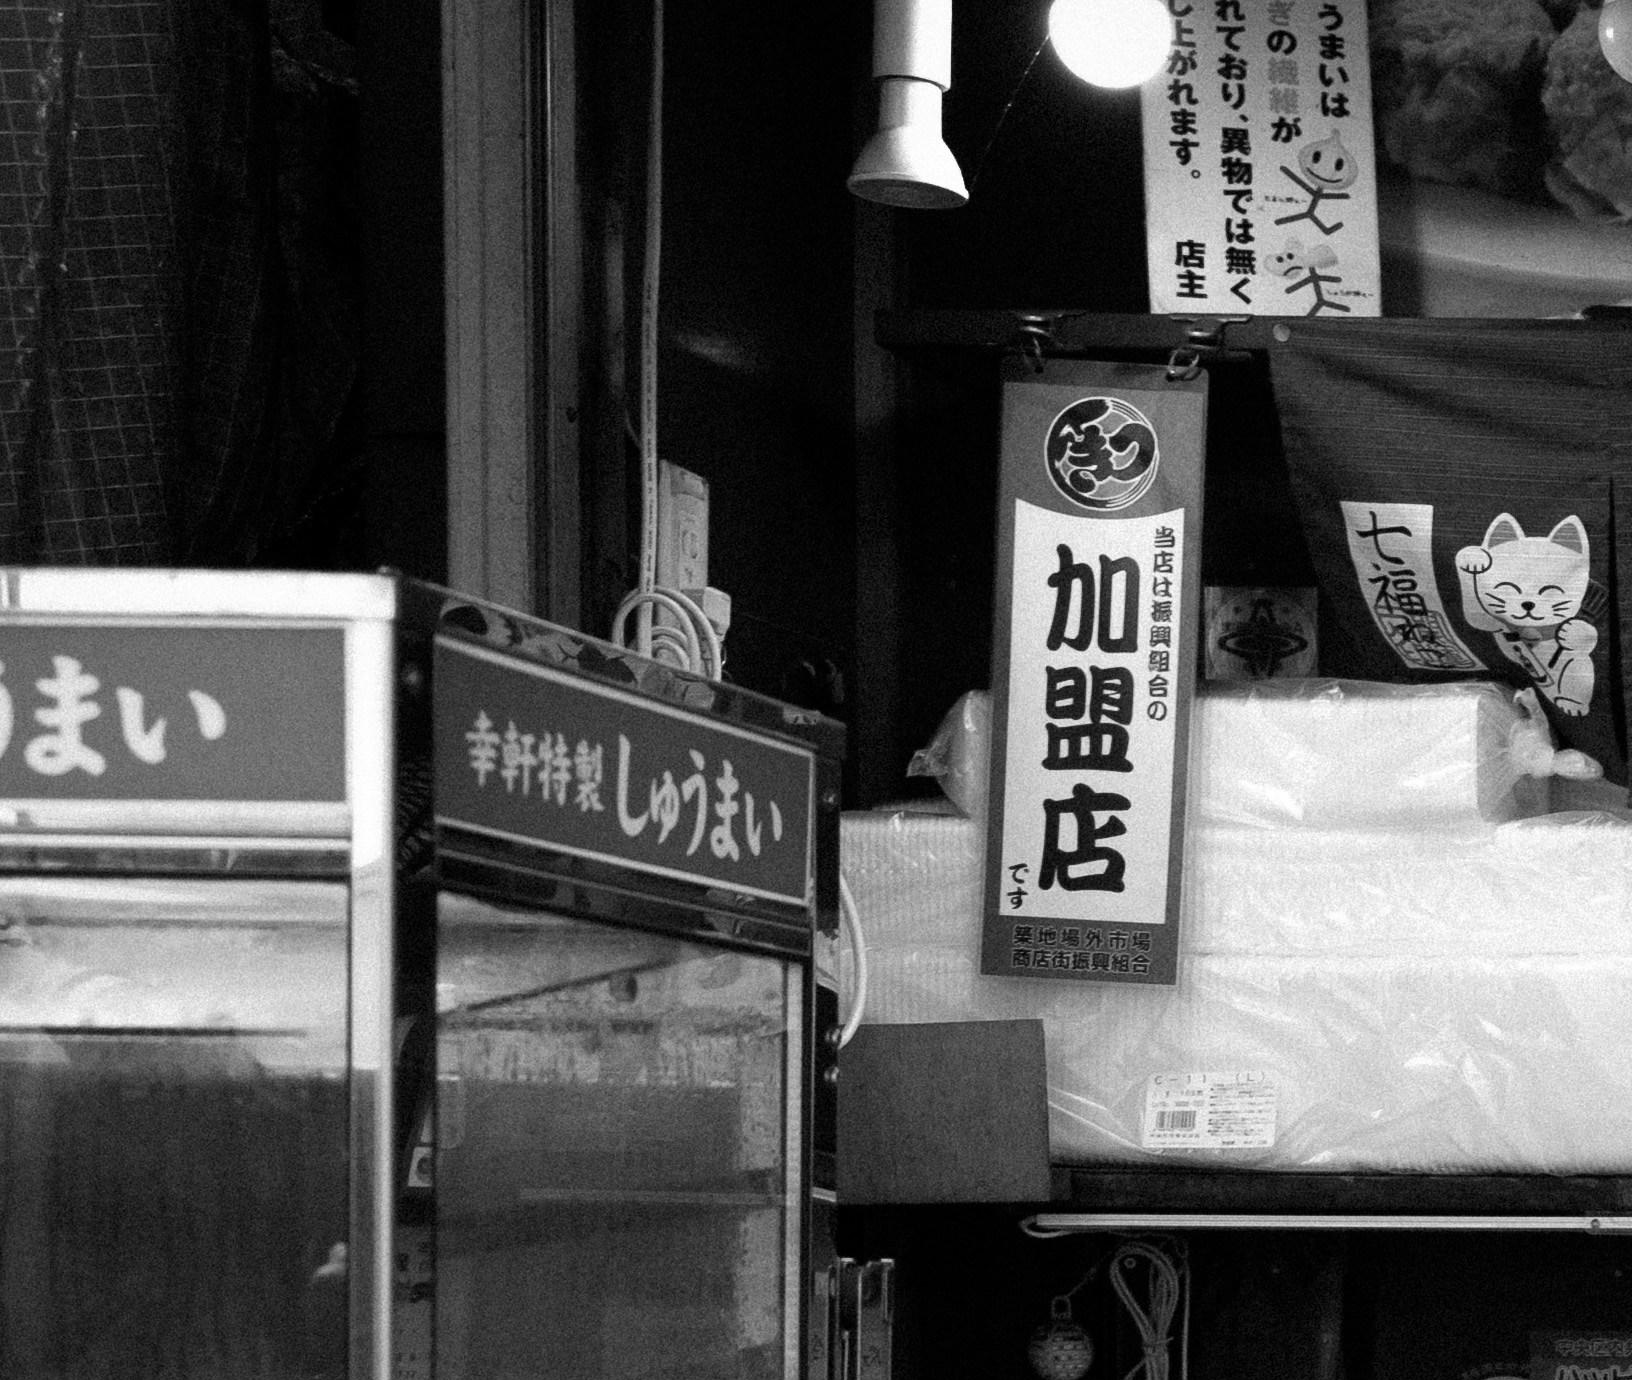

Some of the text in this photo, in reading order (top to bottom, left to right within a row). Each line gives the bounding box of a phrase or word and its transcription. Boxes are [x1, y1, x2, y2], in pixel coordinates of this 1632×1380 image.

[1174, 240, 1208, 299] 店主
[1147, 526, 1175, 722] 当店は振興組合の
[0, 650, 226, 777] まい
[1037, 543, 1141, 894] 加盟店
[466, 708, 783, 863] 幸軒特製 しゅうまい
[1007, 862, 1029, 910] です
[1012, 948, 1151, 975] 商店街振興組合
[1014, 924, 1152, 953] 築地場外市場
